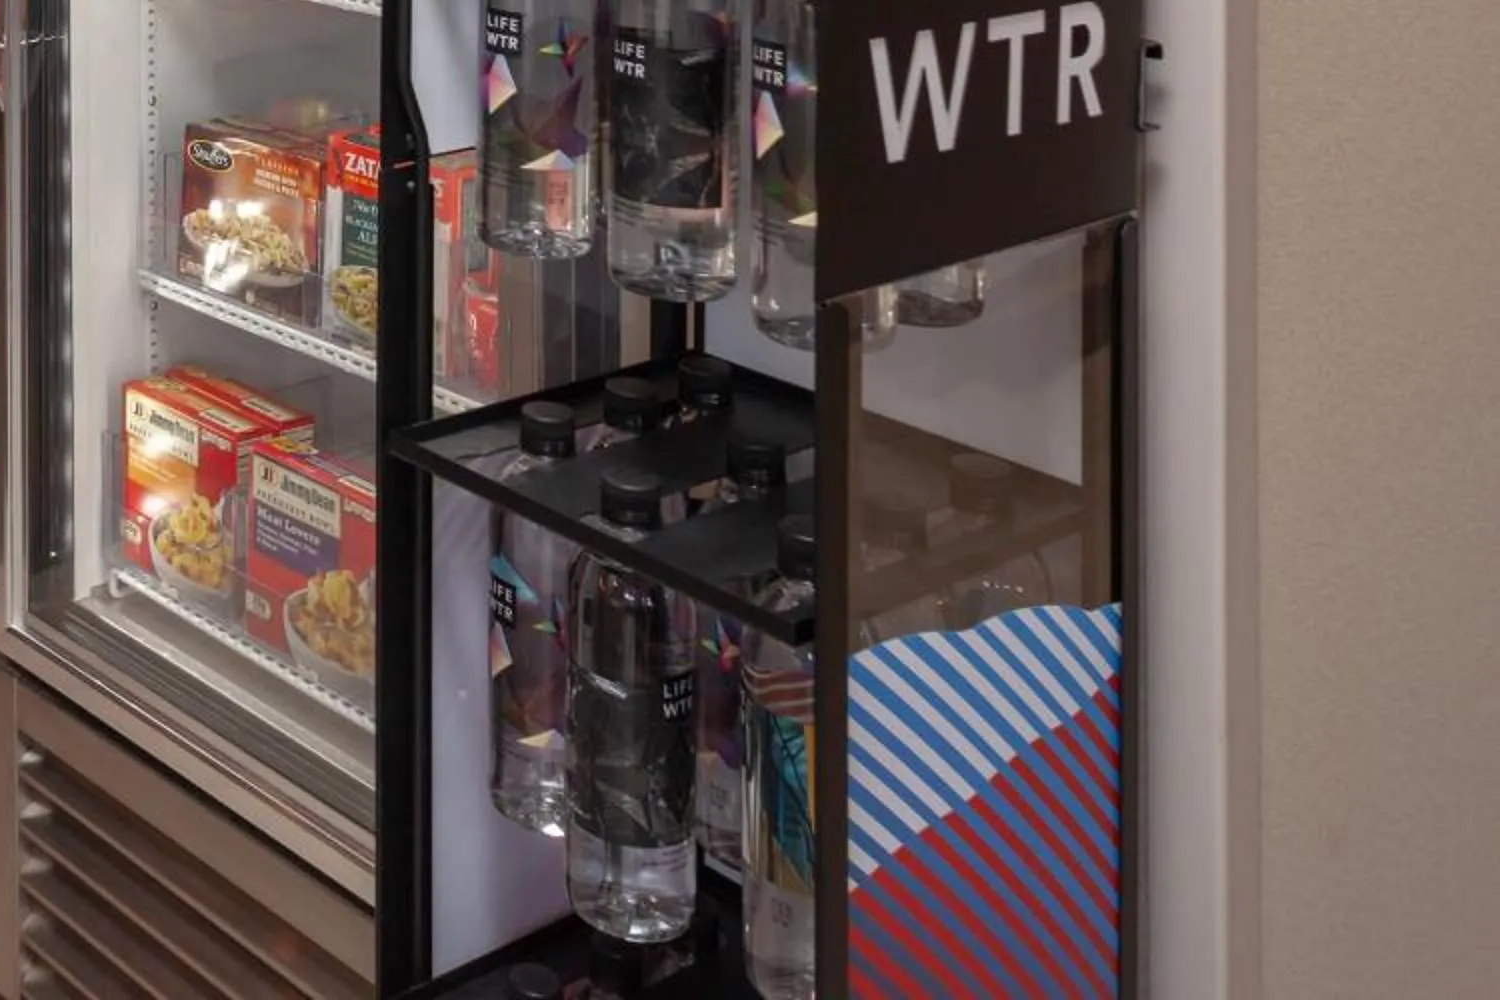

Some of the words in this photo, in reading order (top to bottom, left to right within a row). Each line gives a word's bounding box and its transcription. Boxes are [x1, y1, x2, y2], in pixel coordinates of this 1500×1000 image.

[486, 11, 520, 33] LIFE
[486, 31, 520, 51] WTR
[614, 39, 646, 60] LIFE
[753, 44, 784, 67] LIFE
[614, 58, 646, 79] WTR
[753, 64, 784, 88] WTR
[869, 1, 1106, 165] WTR
[492, 578, 513, 602] IFE
[492, 599, 514, 621] TR
